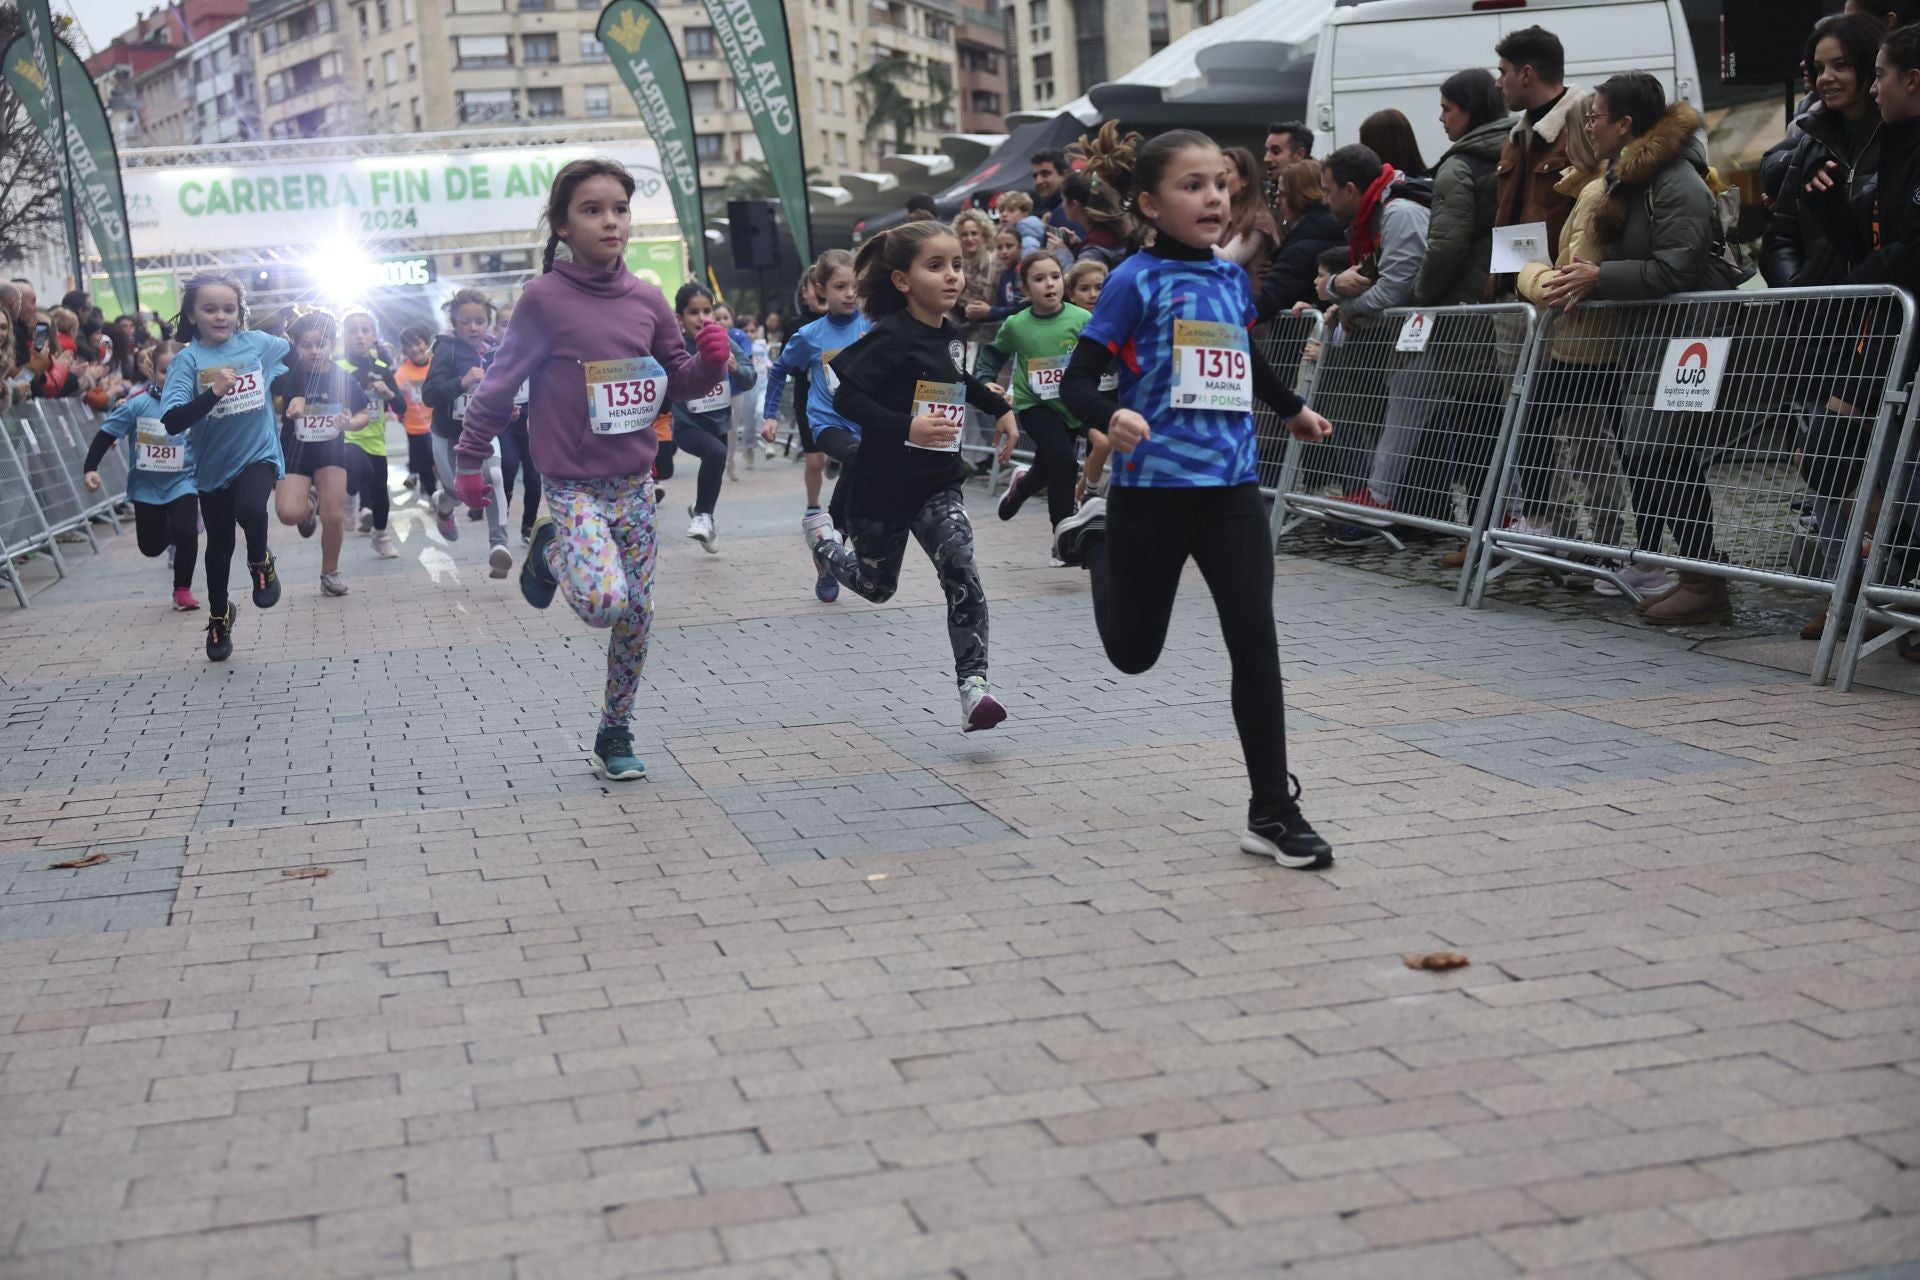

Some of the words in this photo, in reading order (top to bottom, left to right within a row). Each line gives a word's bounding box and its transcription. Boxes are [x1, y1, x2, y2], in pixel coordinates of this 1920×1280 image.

[177, 173, 359, 217] CARRERA
[370, 168, 431, 206] FIN
[445, 165, 491, 201] DE
[361, 207, 417, 231] 2024
[1195, 348, 1245, 380] 1319
[602, 379, 656, 408] 1338
[1205, 380, 1241, 391] MARINA
[608, 405, 654, 418] HENARUSKA
[303, 415, 334, 429] 1275
[145, 445, 176, 458] 1281
